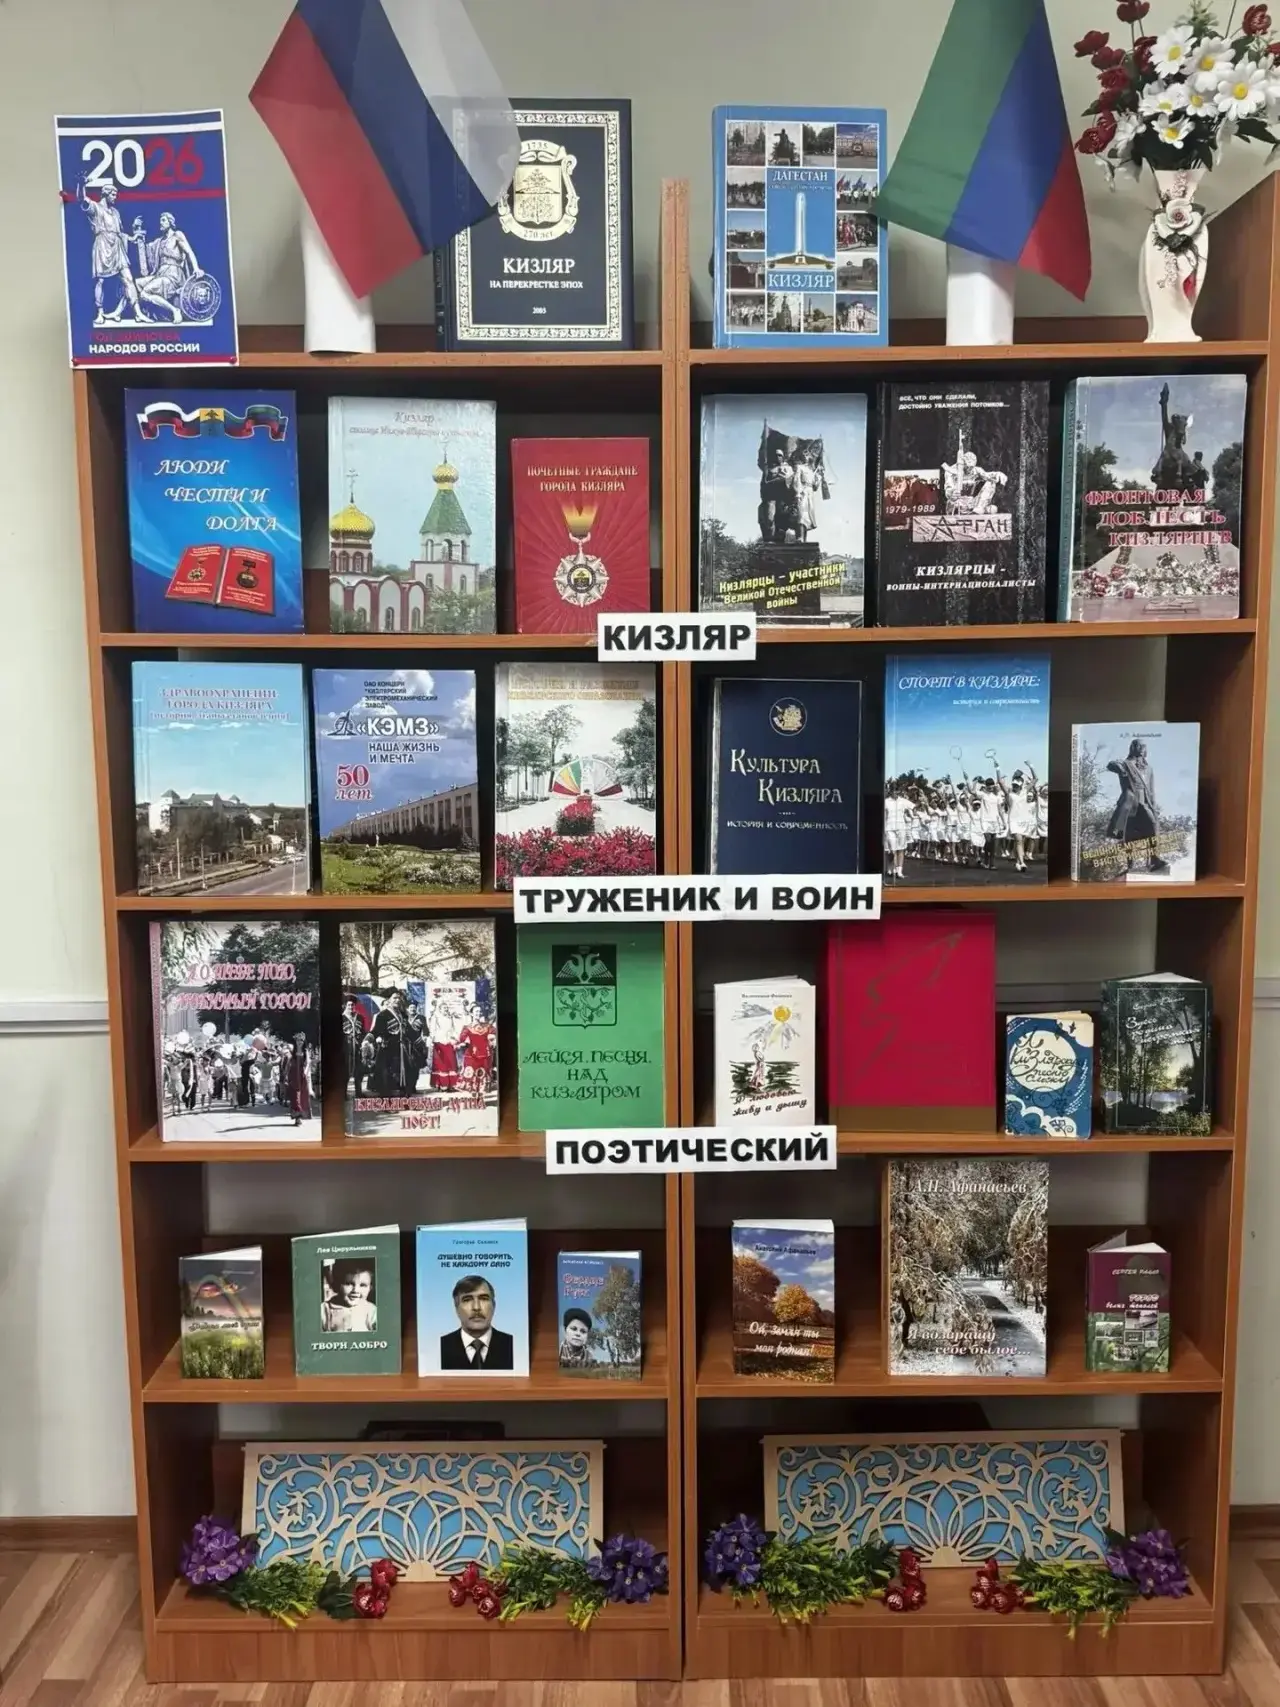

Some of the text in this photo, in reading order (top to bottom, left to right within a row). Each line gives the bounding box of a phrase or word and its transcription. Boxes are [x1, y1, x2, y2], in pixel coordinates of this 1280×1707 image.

[82, 137, 204, 188] 2026
[773, 170, 828, 181] ДАГЕСТАН
[503, 258, 575, 274] КИЗЛЯР
[489, 280, 583, 289] НА ПЕРЕКРЕСТКЕ ЭПОХ
[768, 273, 835, 288] КИЗЛЯР
[89, 342, 200, 355] НАРОДОВ РОССИИ
[154, 460, 230, 475] ЛЮДИ
[528, 465, 638, 477] ПОЧЕТНЫЕ ГРАЖДАНЕ
[540, 480, 625, 493] ГОРОДА КИЗЛЯРА
[165, 487, 270, 504] ЧЕСТИ И
[1085, 489, 1206, 506] ФРОНТОВАЯ
[886, 504, 935, 514] 1979-1989
[206, 516, 279, 532] ДОЛГА
[1097, 507, 1226, 529] ДОБЛЕСТЬ
[1109, 531, 1232, 547] КИЗЛЯРЦЕВ
[720, 574, 775, 592] Кизлярцы
[789, 562, 846, 584] участники
[916, 565, 996, 577] КИЗЛЯРЦЫ
[723, 576, 841, 605] Великой Отечественной
[886, 579, 1036, 591] ВОИНЫ-ИНТЕРНАЦИОНАЛИСТЫ
[766, 596, 798, 610] войны
[604, 624, 750, 651] КИЗЛЯР
[899, 675, 1040, 690] СПОРТ В КИЗЛЯРЕ:
[357, 717, 439, 736] «КЭМЗ»
[369, 743, 440, 752] НАША ЖИЗНЬ
[369, 753, 414, 763] И МЕЧТА
[336, 765, 370, 787] 50
[336, 788, 372, 800] лет
[727, 820, 764, 829] ИСТОРИЯ
[767, 821, 773, 829] И
[519, 886, 874, 914] ТРУЖЕНИК И ВОИН
[567, 1069, 608, 1085] НАД
[531, 1086, 641, 1105] КИЗЛЯРОМ
[354, 1097, 443, 1112] КИЗЛЯРСКАЯ
[732, 1104, 761, 1116] живу
[556, 1132, 828, 1164] ПОЭТИЧЕСКИЙ
[950, 1179, 1027, 1196] Афанасьев
[907, 1329, 997, 1343] Я возвращу
[311, 1341, 388, 1350] ТВОРИ ДОБРО
[935, 1344, 967, 1355] себе
